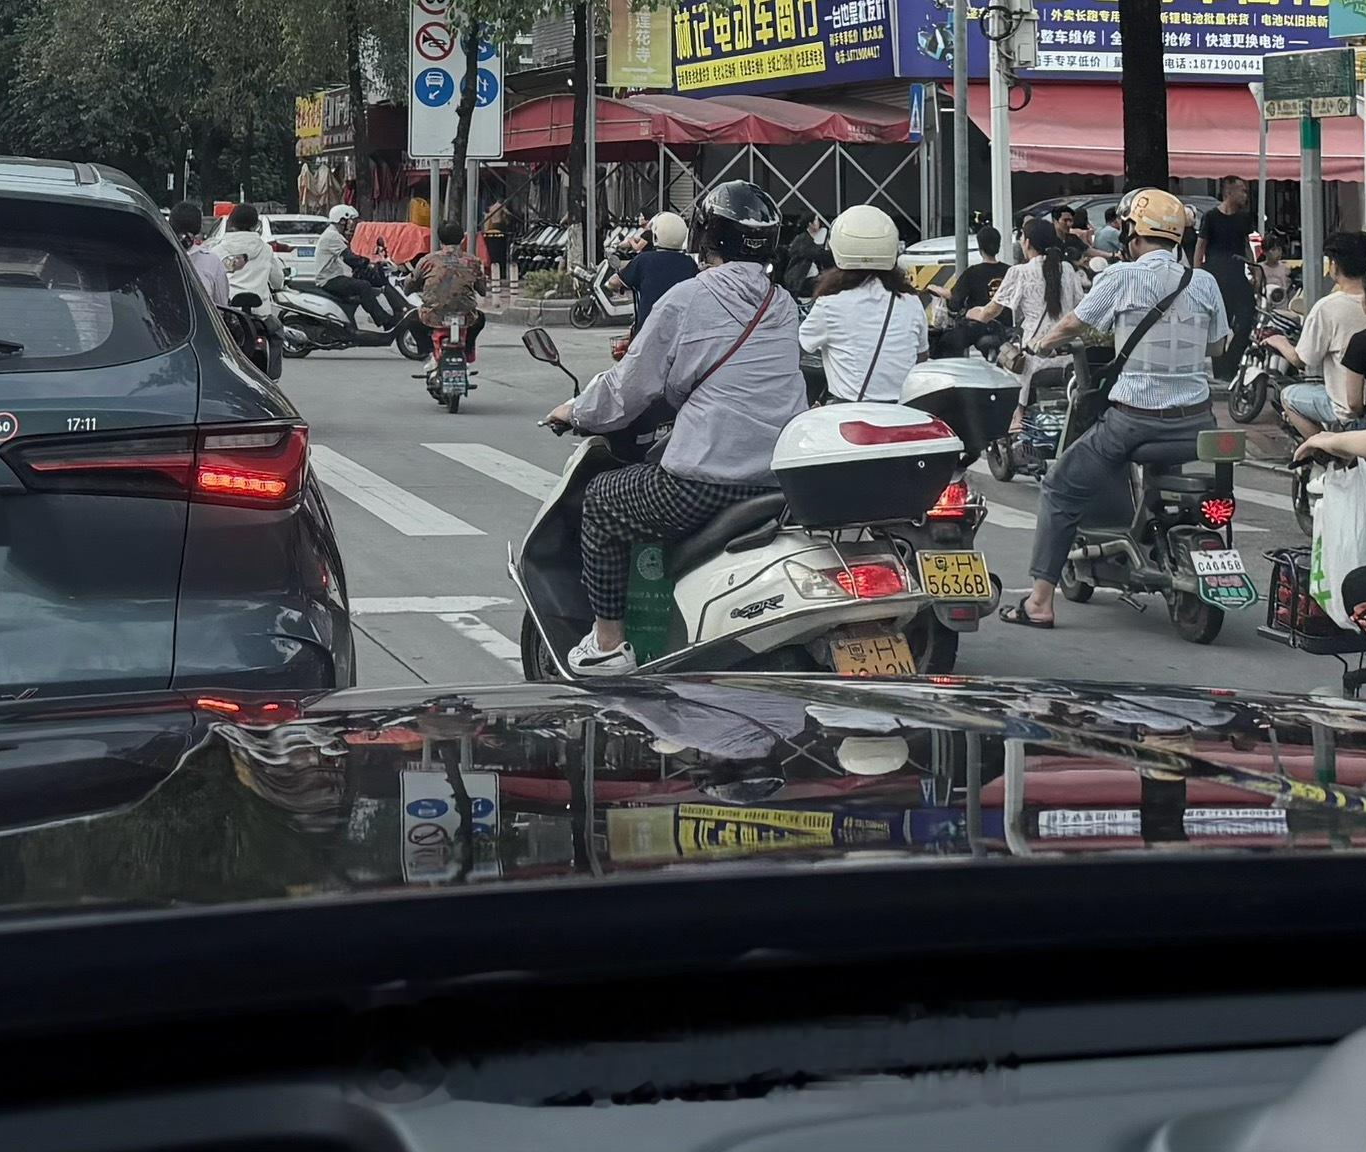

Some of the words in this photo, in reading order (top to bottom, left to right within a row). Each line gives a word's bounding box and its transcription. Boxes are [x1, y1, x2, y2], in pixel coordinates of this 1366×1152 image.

[1261, 14, 1328, 28] 电池以旧换新
[1036, 30, 1097, 45] 整车维修
[1205, 33, 1285, 49] 快速更换电池
[66, 416, 97, 431] 17:11
[928, 574, 985, 594] 5636B
